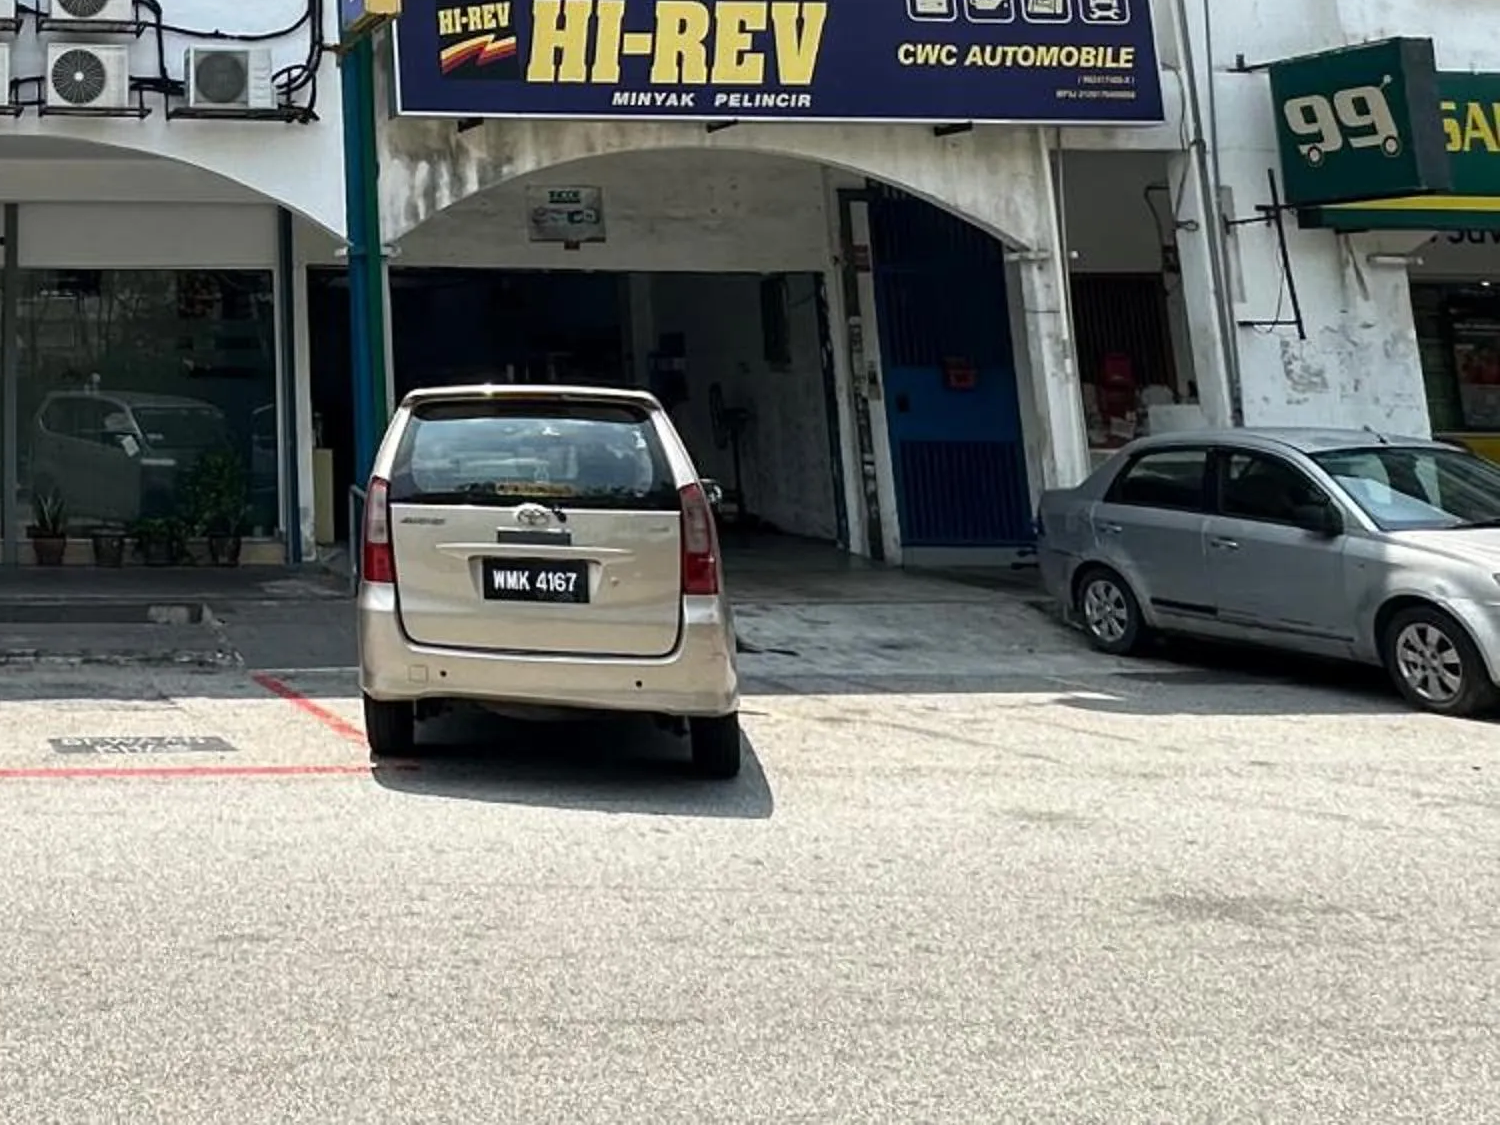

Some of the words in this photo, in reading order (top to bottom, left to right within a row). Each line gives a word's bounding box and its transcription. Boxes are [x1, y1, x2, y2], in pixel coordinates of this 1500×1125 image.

[438, 1, 512, 36] HI-REV
[897, 42, 958, 67] CWC
[963, 45, 1136, 70] AUTOMOBILE
[611, 91, 696, 108] MINYAK
[713, 92, 813, 109] PELINCIR
[1439, 100, 1500, 153] SA
[492, 569, 530, 591] WMK
[535, 571, 577, 593] 4167
